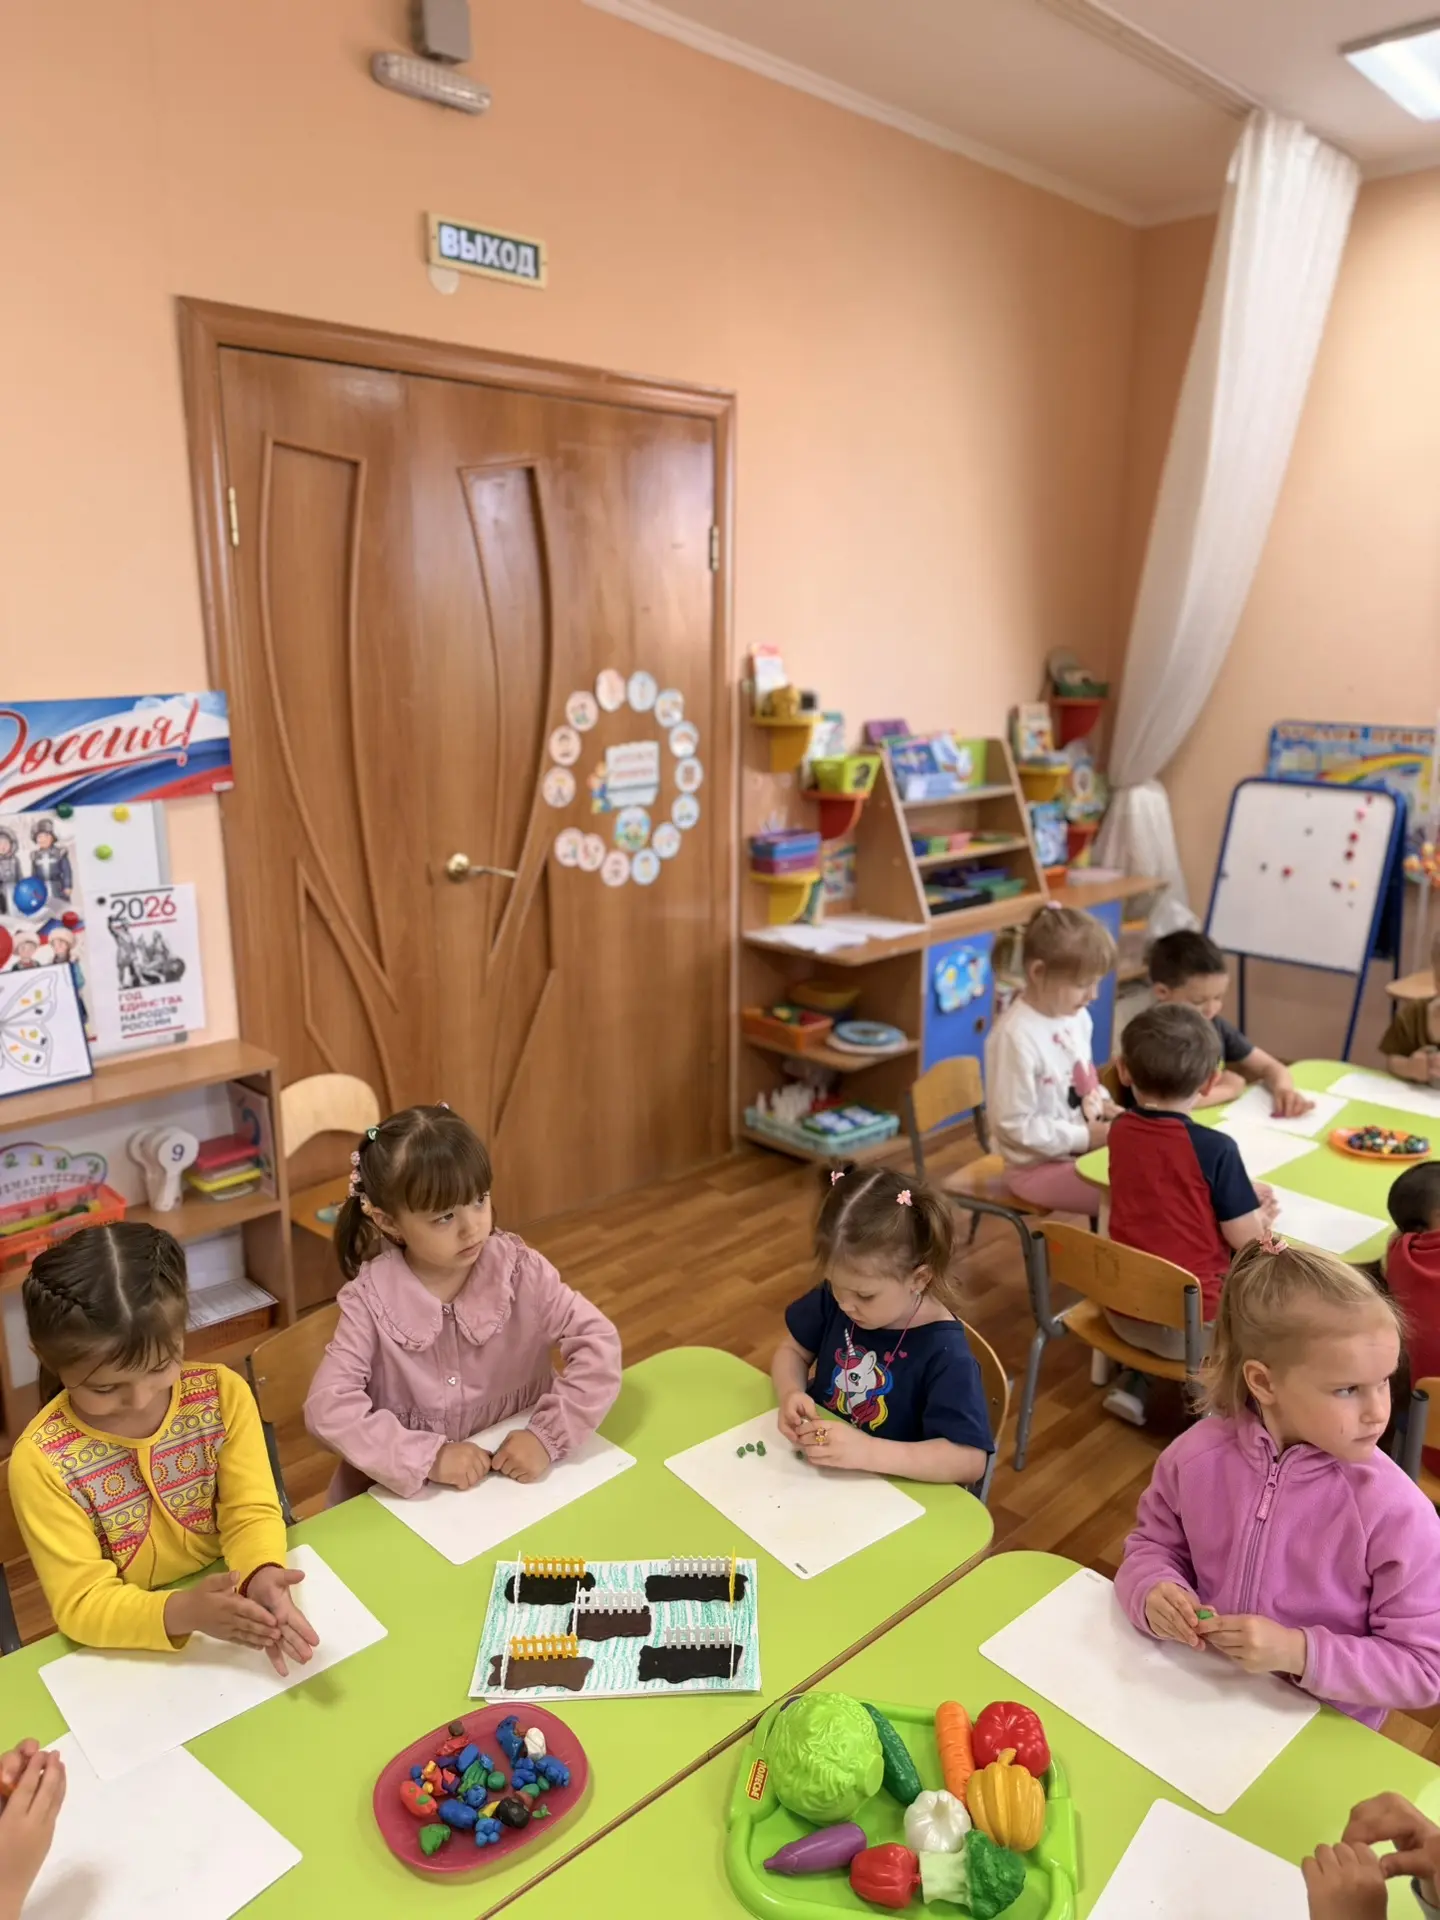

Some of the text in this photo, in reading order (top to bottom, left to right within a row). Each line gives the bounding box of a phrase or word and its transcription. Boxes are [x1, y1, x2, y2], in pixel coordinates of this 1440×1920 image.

[440, 225, 536, 278] ВЫХОД
[110, 894, 177, 922] 2026
[118, 990, 142, 1002] ГОД
[120, 1005, 178, 1022] НАРОДОВ
[121, 1016, 171, 1032] РОССИИ
[171, 1143, 185, 1162] 9
[750, 1760, 767, 1799] ПОЛЕСЬЕ
